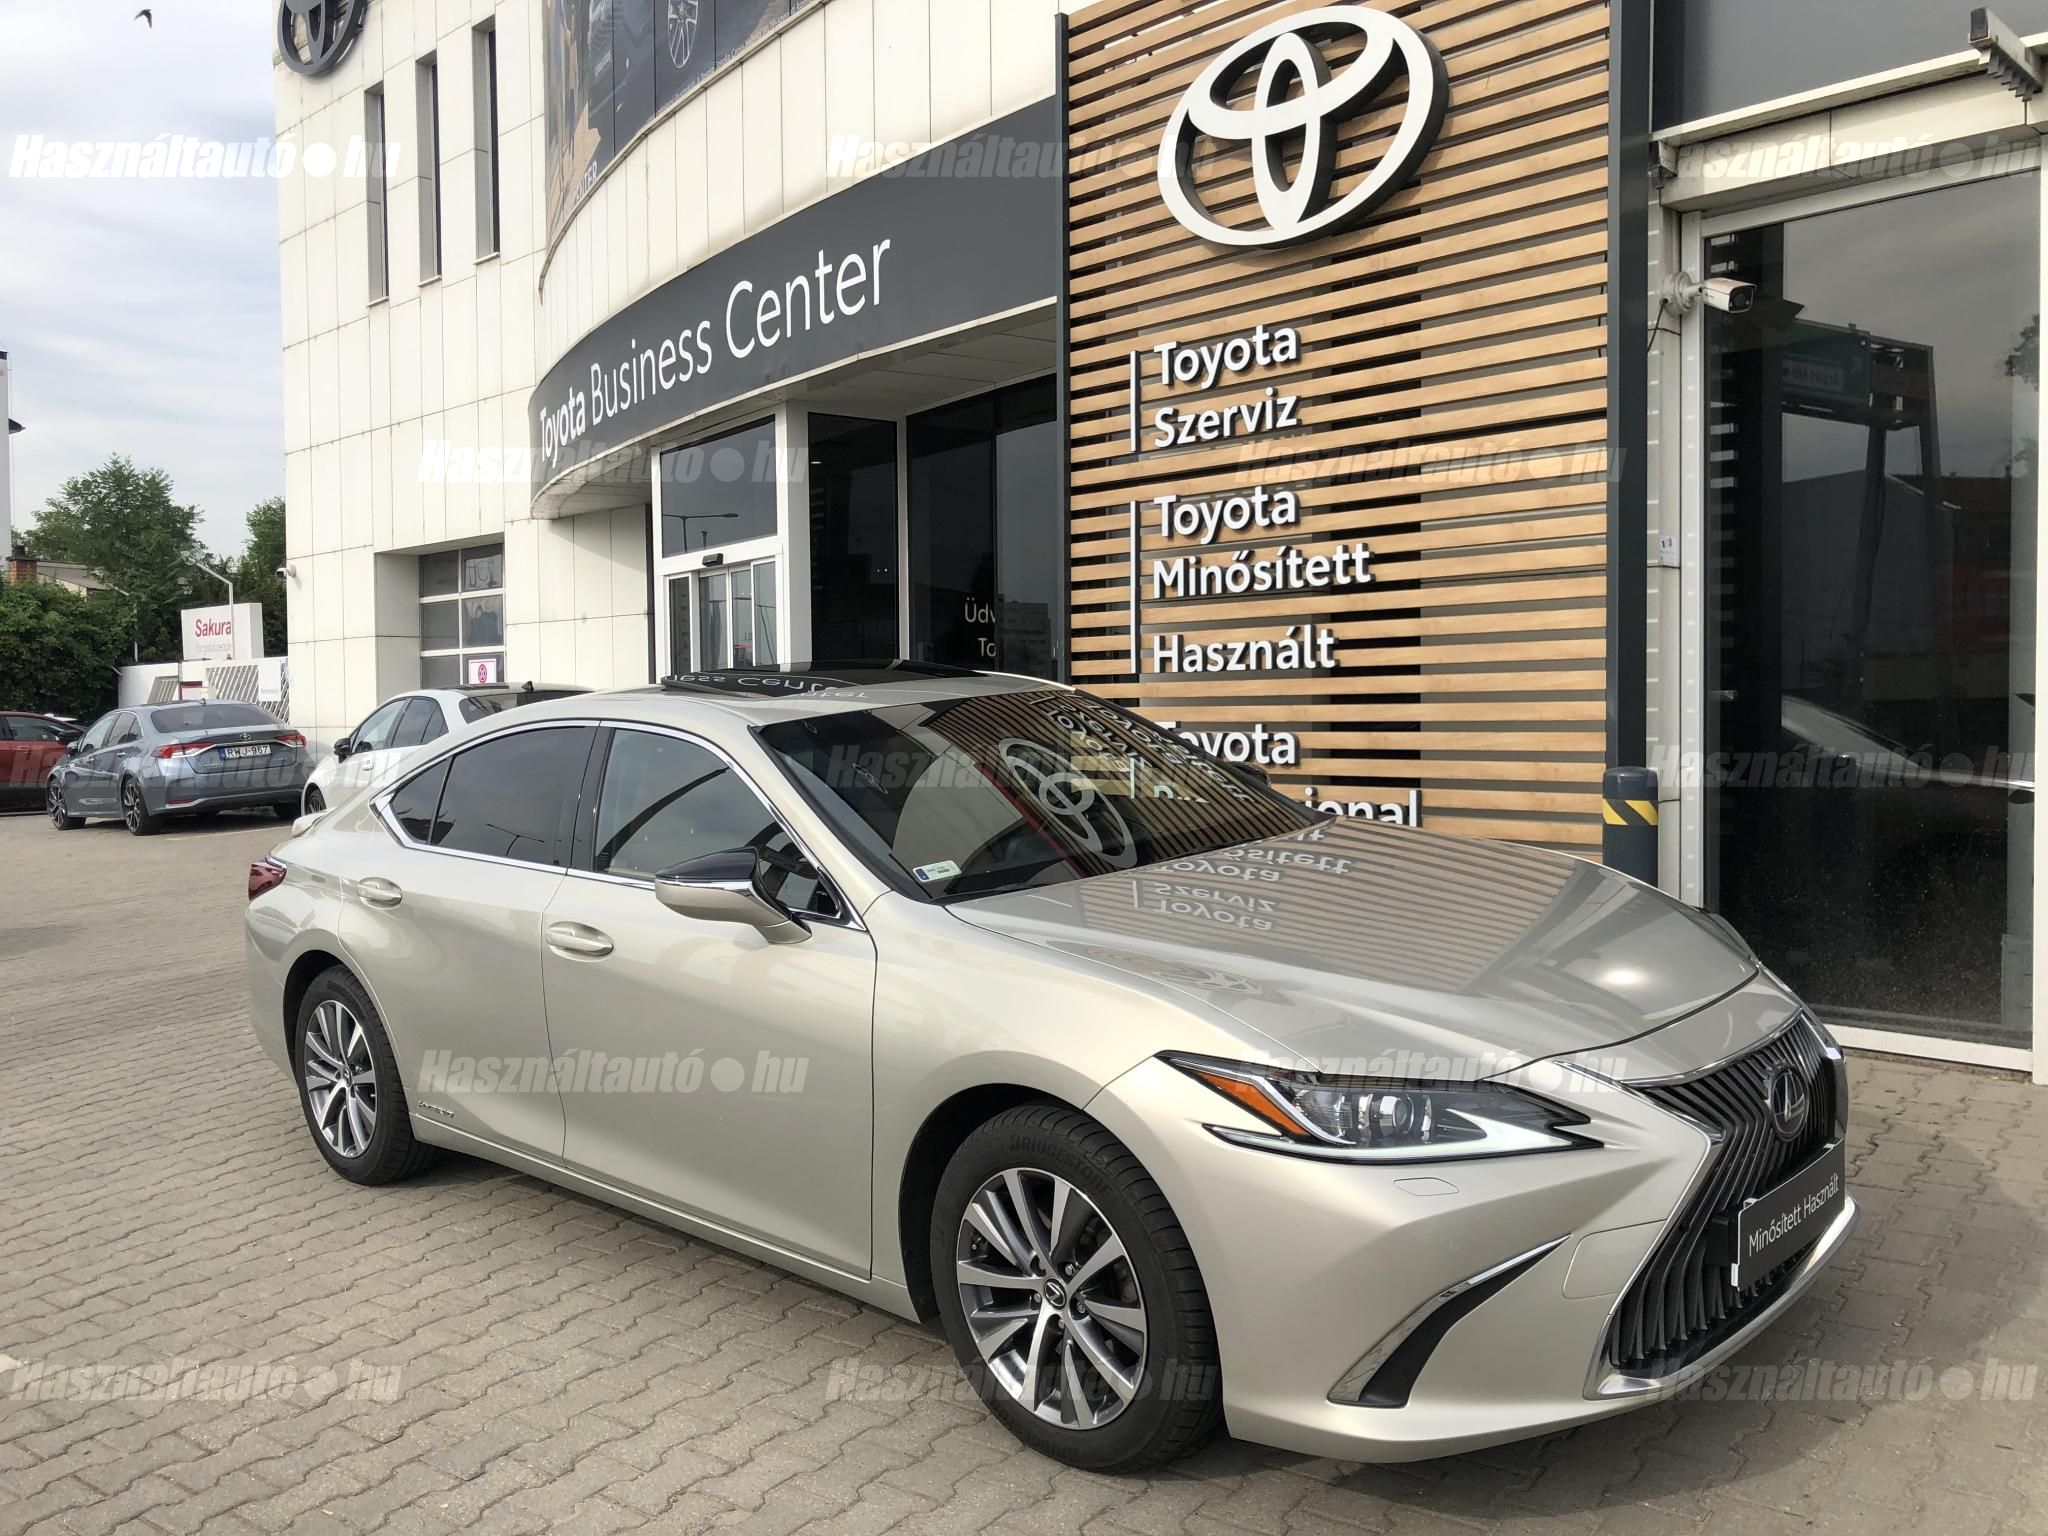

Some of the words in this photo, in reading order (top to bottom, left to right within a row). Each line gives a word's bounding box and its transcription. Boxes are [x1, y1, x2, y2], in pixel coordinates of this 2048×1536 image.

[540, 386, 585, 468] Toyota
[591, 319, 712, 426] Business
[726, 239, 891, 358] Center
[1154, 325, 1298, 389] Toyota
[1154, 387, 1298, 448] Szerviz
[1154, 486, 1297, 544] Toyota
[1153, 542, 1372, 599] Minősített
[195, 618, 231, 637] Sakura
[1153, 624, 1336, 673] Használt
[227, 745, 269, 758] RWJ-967
[1749, 1204, 1802, 1257] Minősített
[1803, 1172, 1839, 1219] Használt
